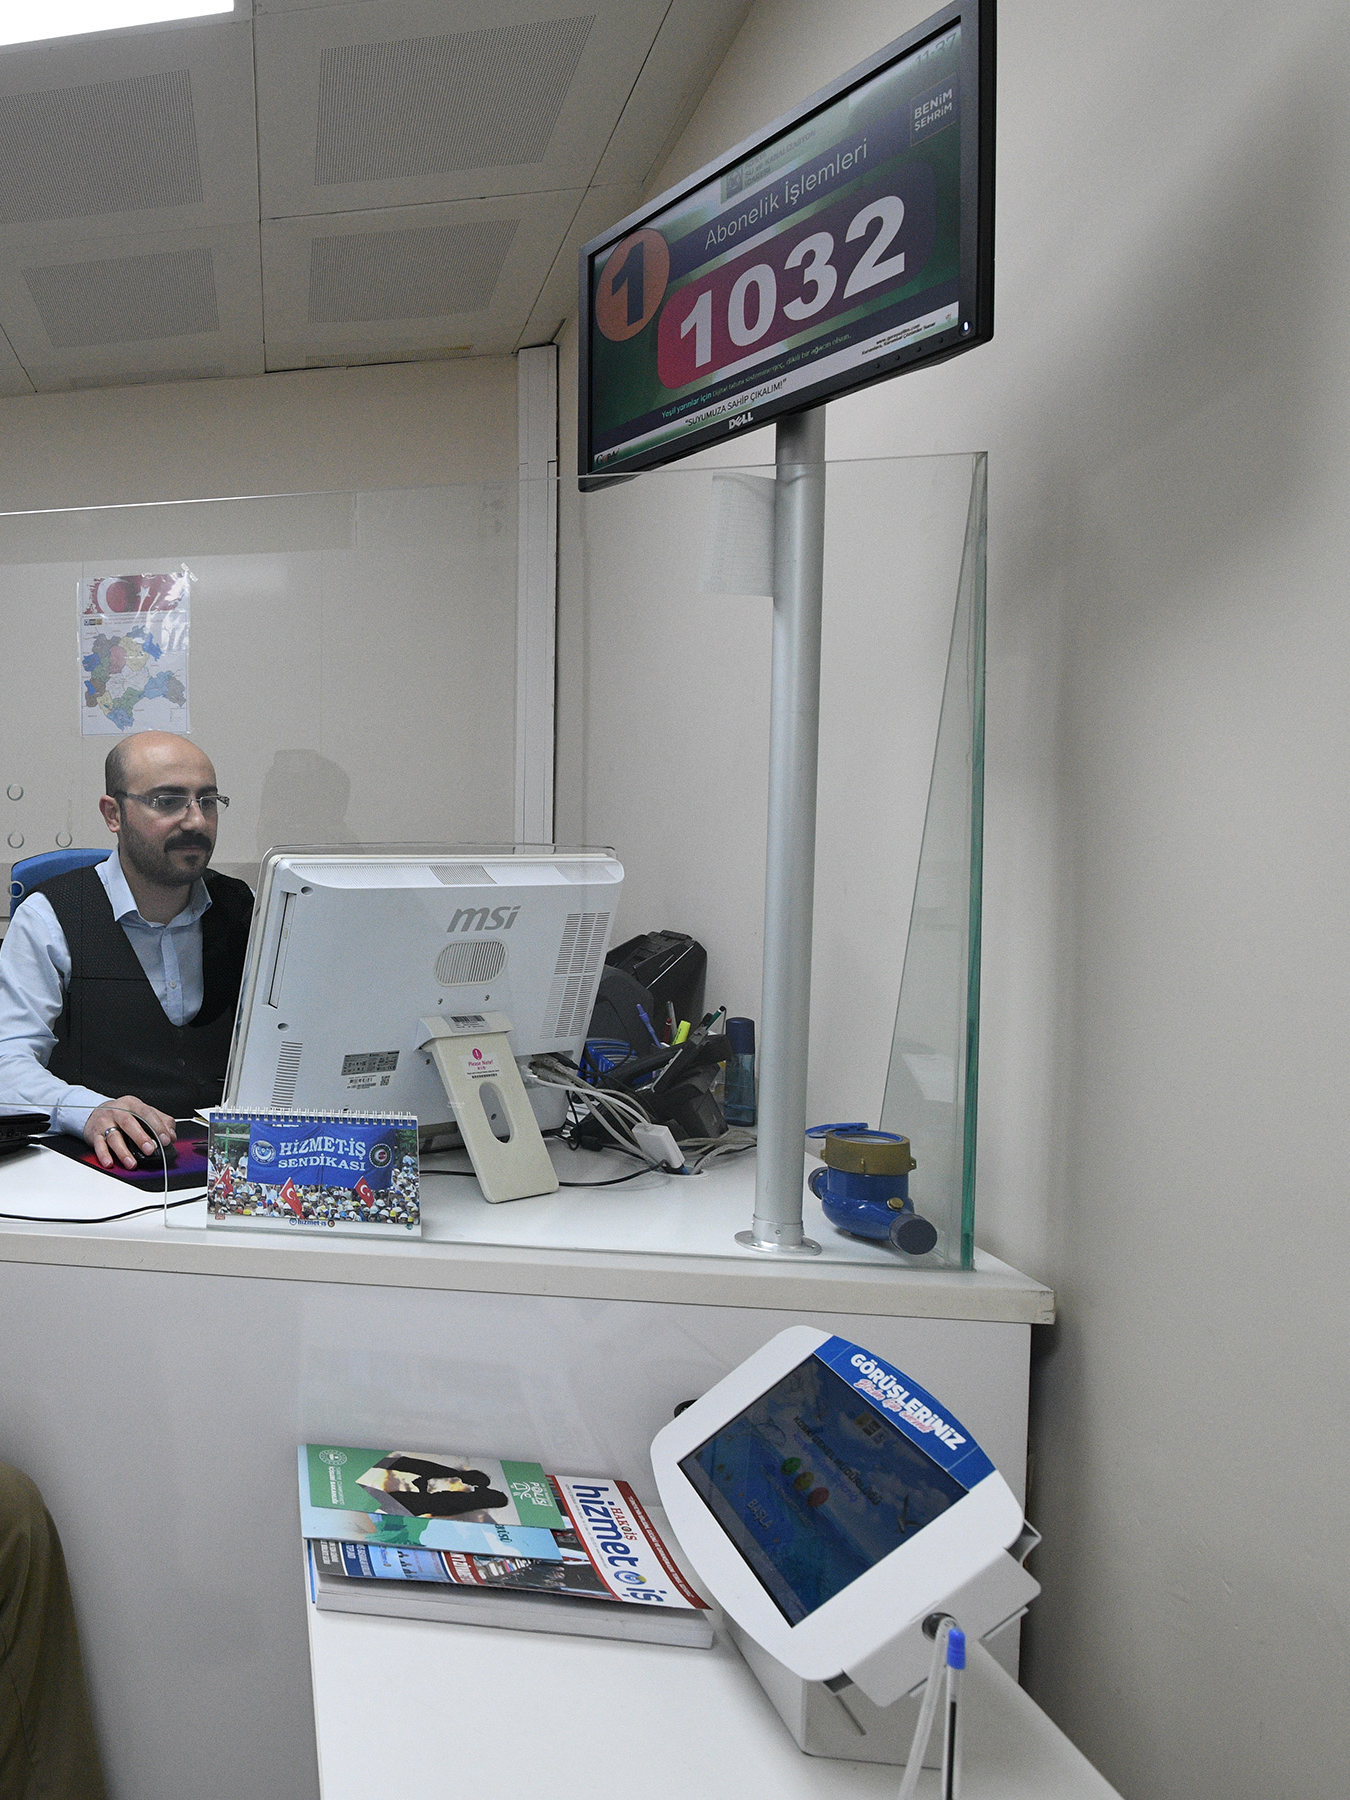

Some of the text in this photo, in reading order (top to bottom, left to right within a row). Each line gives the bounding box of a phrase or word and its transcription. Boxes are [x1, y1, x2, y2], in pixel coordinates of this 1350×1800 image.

[705, 138, 867, 250] Abonelik İşlemleri
[611, 240, 644, 326] 1
[680, 195, 905, 368] 1032
[727, 394, 750, 410] SAHİP
[728, 412, 754, 430] DELL
[446, 905, 521, 933] msi
[278, 1136, 367, 1161] HİZMET-İŞ
[278, 1153, 366, 1171] SENDİKASI
[850, 1353, 967, 1450] GÖRÜŞLERİNİZ
[572, 1484, 640, 1567] hizmet
